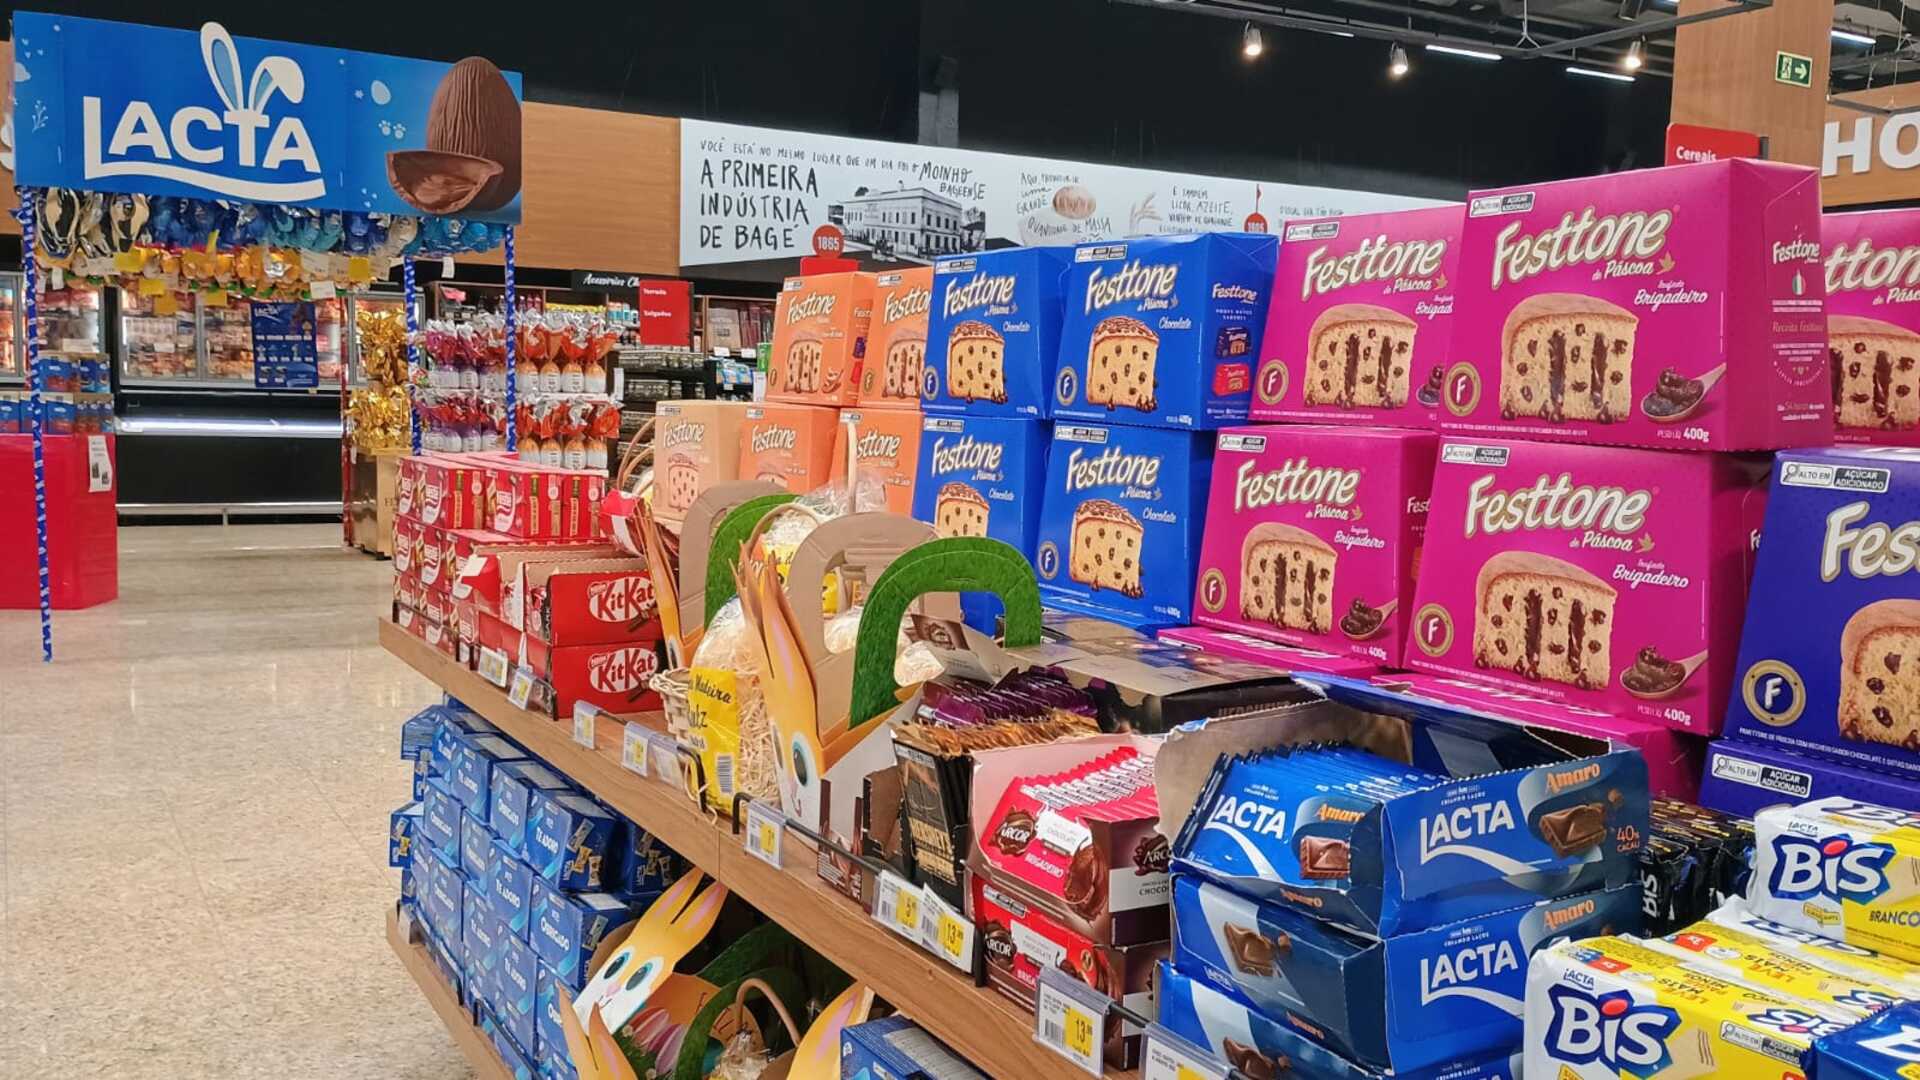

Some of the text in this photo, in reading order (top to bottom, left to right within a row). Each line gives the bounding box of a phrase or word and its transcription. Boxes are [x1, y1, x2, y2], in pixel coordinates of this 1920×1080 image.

[82, 96, 326, 202] LACTA
[1675, 146, 1717, 161] Cereais
[700, 159, 819, 198] A PRIMEIRA
[919, 160, 973, 182] MOINHO
[939, 181, 986, 201] BAGEENSE
[700, 192, 810, 225] INDÚSTRIA
[700, 223, 800, 250] DE BAGÉ
[1490, 205, 1673, 290] Festtone
[1773, 239, 1820, 265] Festtone
[1301, 233, 1447, 303] Festtone
[1604, 259, 1654, 280] Páscoa
[943, 270, 1016, 321] Festtone
[1085, 258, 1179, 316] Festtone
[1212, 282, 1258, 300] Festtone
[1393, 278, 1432, 293] Páscoa
[786, 291, 837, 326] Festtone
[1634, 290, 1708, 313] Brigadeiro
[1267, 371, 1277, 394] F
[1455, 376, 1466, 403] F
[663, 418, 704, 449] Festtone
[751, 423, 797, 453] Festtone
[1682, 427, 1709, 443] 400g
[931, 433, 1004, 478] Festtone
[1065, 445, 1161, 494] Festtone
[1798, 470, 1832, 481] ALTO EM
[1844, 468, 1878, 480] AÇÚCAR
[1234, 457, 1361, 514] Festtone
[1834, 478, 1885, 490] ADICIONADO
[1314, 503, 1350, 521] Páscoa
[1464, 472, 1652, 538] Festtone
[1334, 530, 1386, 551] Brigadeiro
[1582, 531, 1633, 552] Páscoa
[1612, 564, 1690, 590] Brigadeiro
[598, 578, 654, 621] KitKat
[1427, 617, 1439, 643] F
[598, 648, 654, 693] KitKat
[1764, 677, 1782, 710] F
[1663, 706, 1692, 726] 400g
[1545, 763, 1601, 795] Amaro
[1761, 778, 1807, 795] ADICIONADO
[1769, 768, 1801, 786] AÇÚCAR
[1203, 793, 1288, 840] LACTA
[1420, 799, 1516, 866] LACTA
[1543, 898, 1595, 930] Amaro
[1420, 939, 1519, 1007] LACTA
[1563, 968, 1596, 991] LACTA
